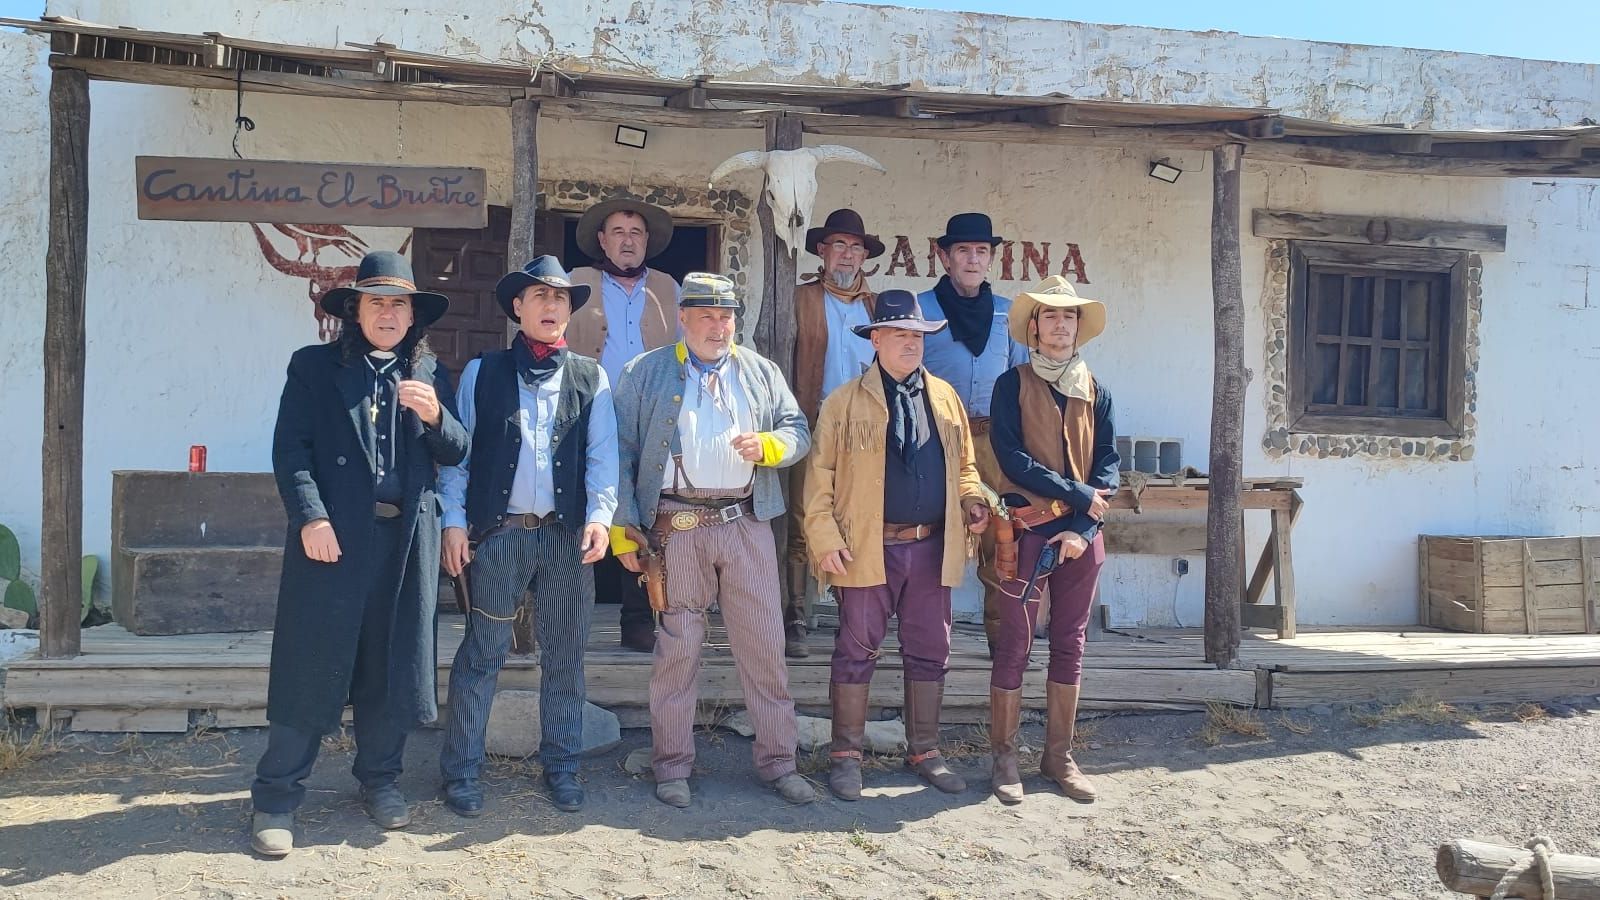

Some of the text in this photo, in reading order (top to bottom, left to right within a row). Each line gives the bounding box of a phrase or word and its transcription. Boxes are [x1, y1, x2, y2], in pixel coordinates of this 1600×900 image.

[144, 168, 312, 202] Cantina
[317, 171, 372, 209] El
[862, 233, 1091, 284] ANINA
